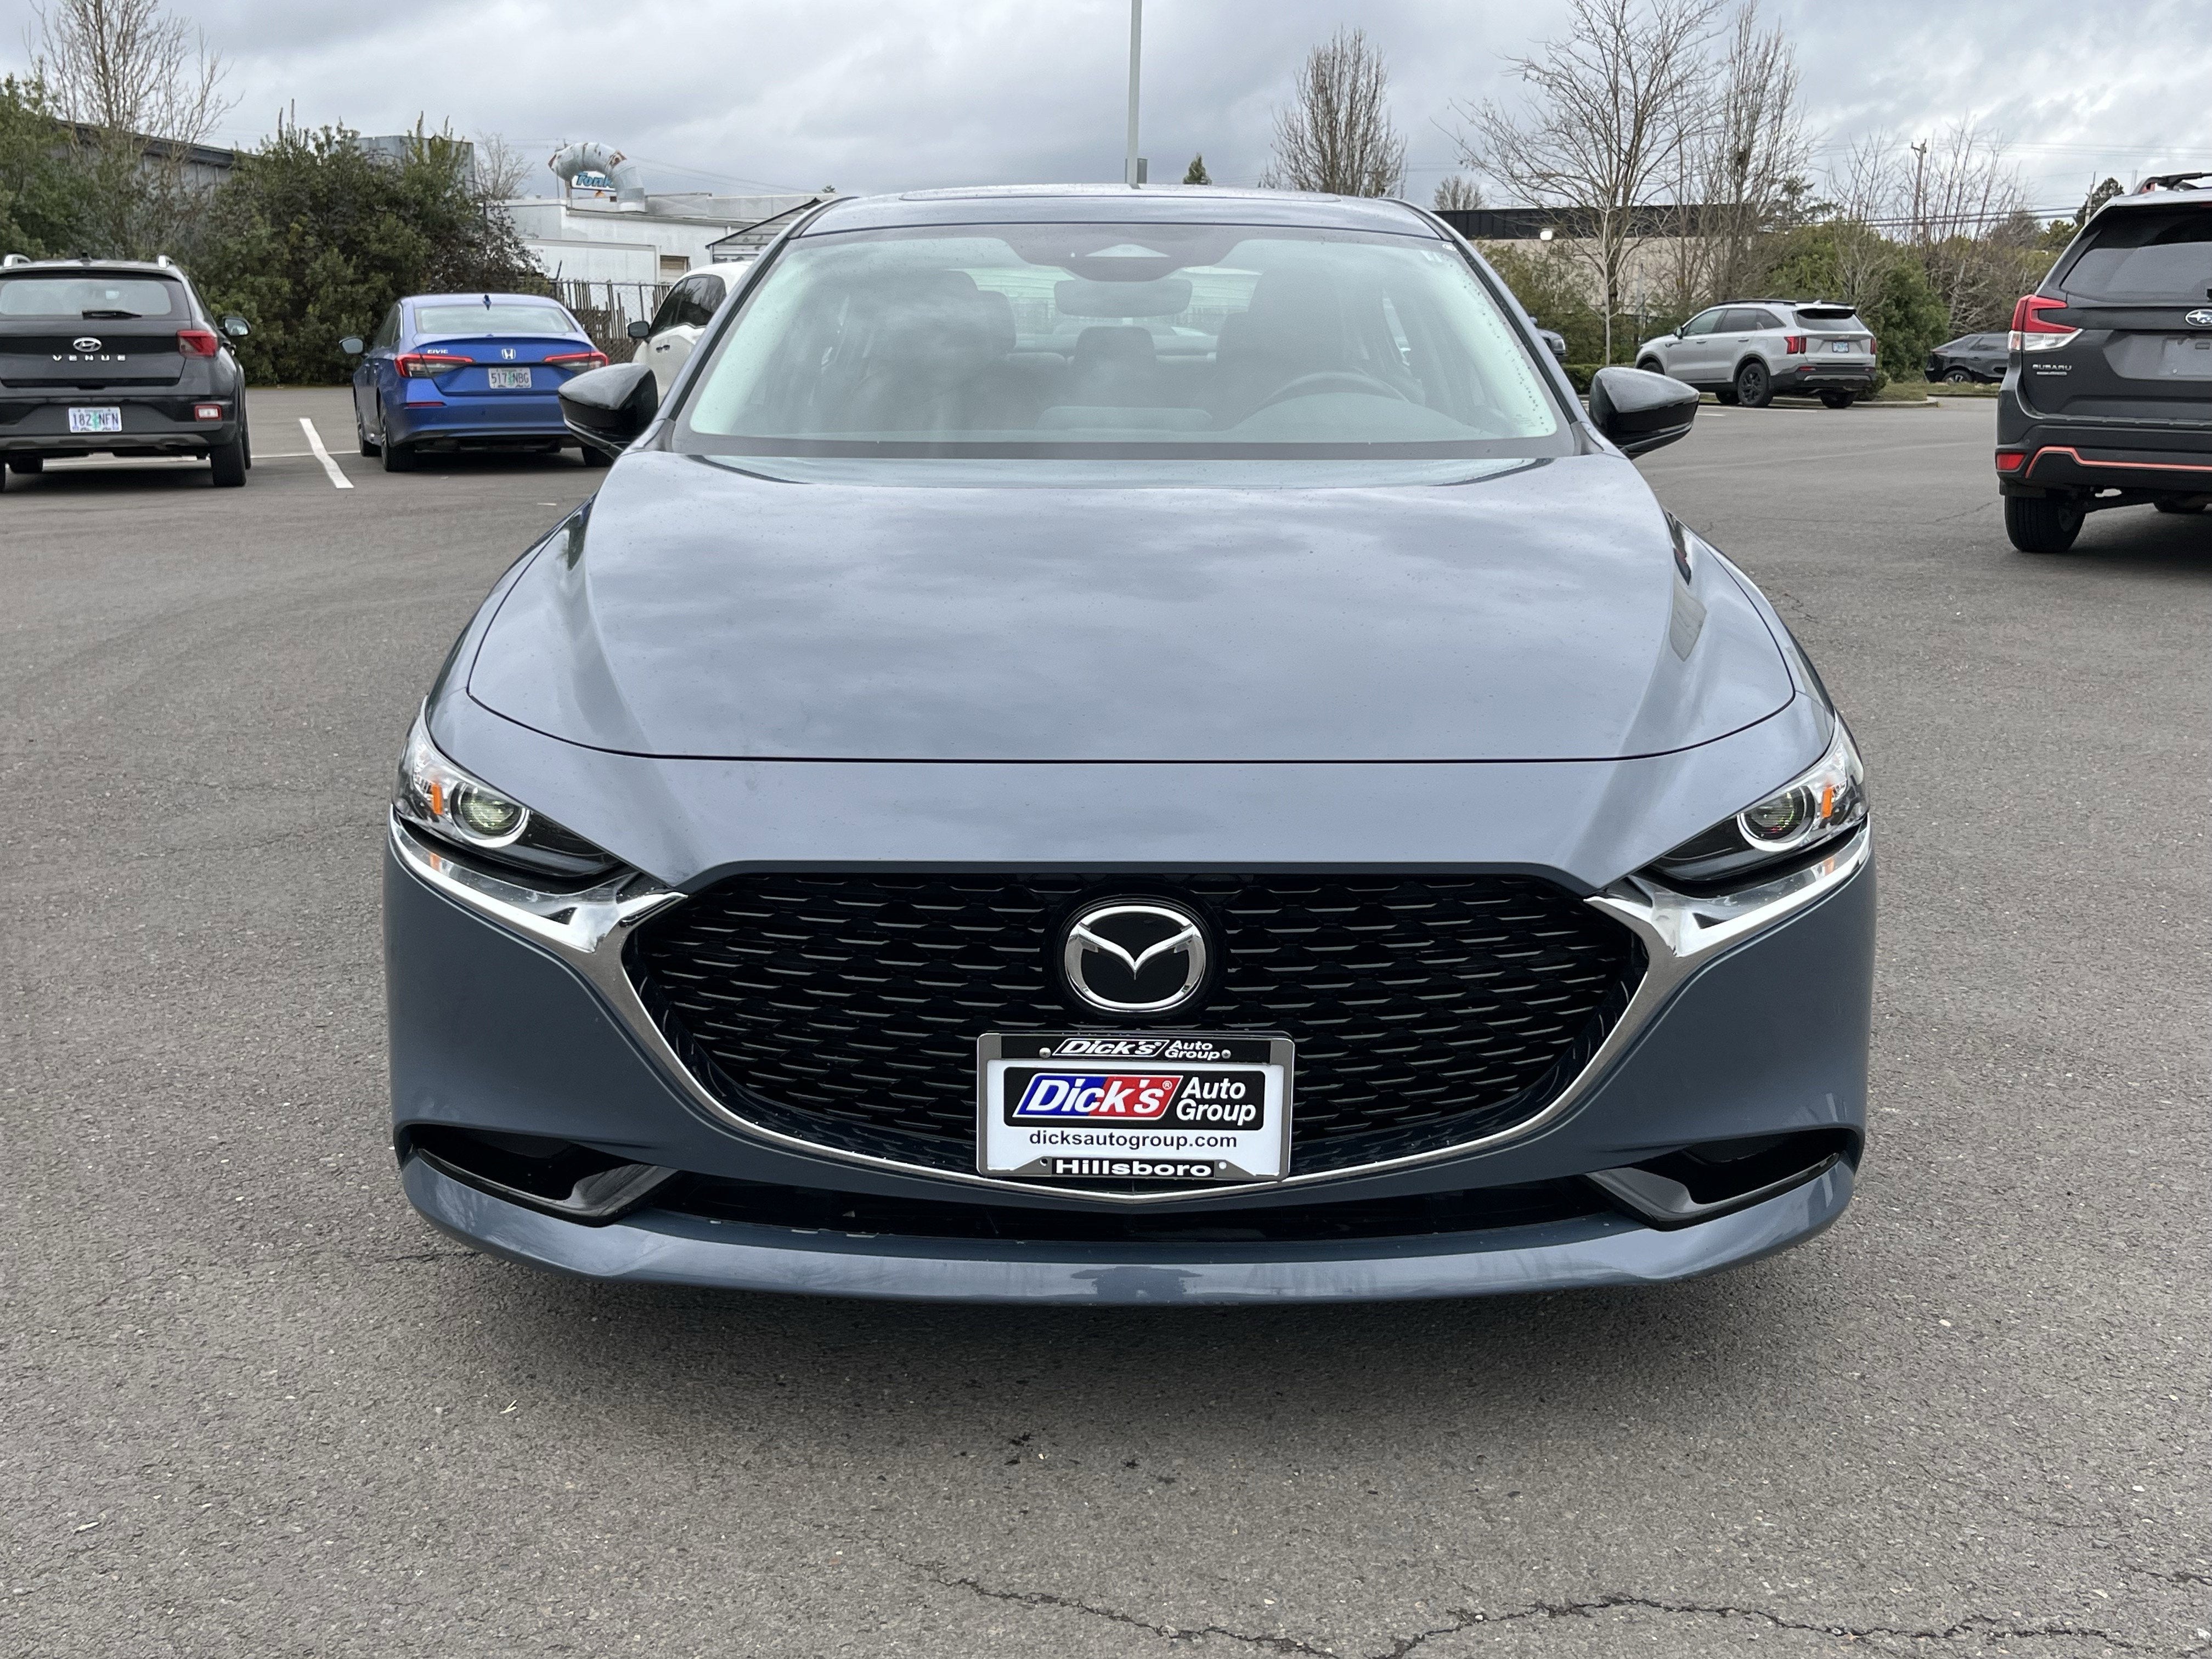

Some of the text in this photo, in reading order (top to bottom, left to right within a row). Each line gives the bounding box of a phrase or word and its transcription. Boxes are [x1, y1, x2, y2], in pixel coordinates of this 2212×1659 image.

[491, 373, 529, 383] 517 NBG
[73, 413, 119, 426] 182 NFN
[1061, 1040, 1213, 1056] Dick's Auto
[1164, 1049, 1220, 1060] Group
[1026, 1077, 1246, 1114] Dick's Auto
[1176, 1099, 1256, 1126] Group
[1029, 1130, 1237, 1150] dicksautogroup.com
[1056, 1159, 1211, 1177] Hillsboro
